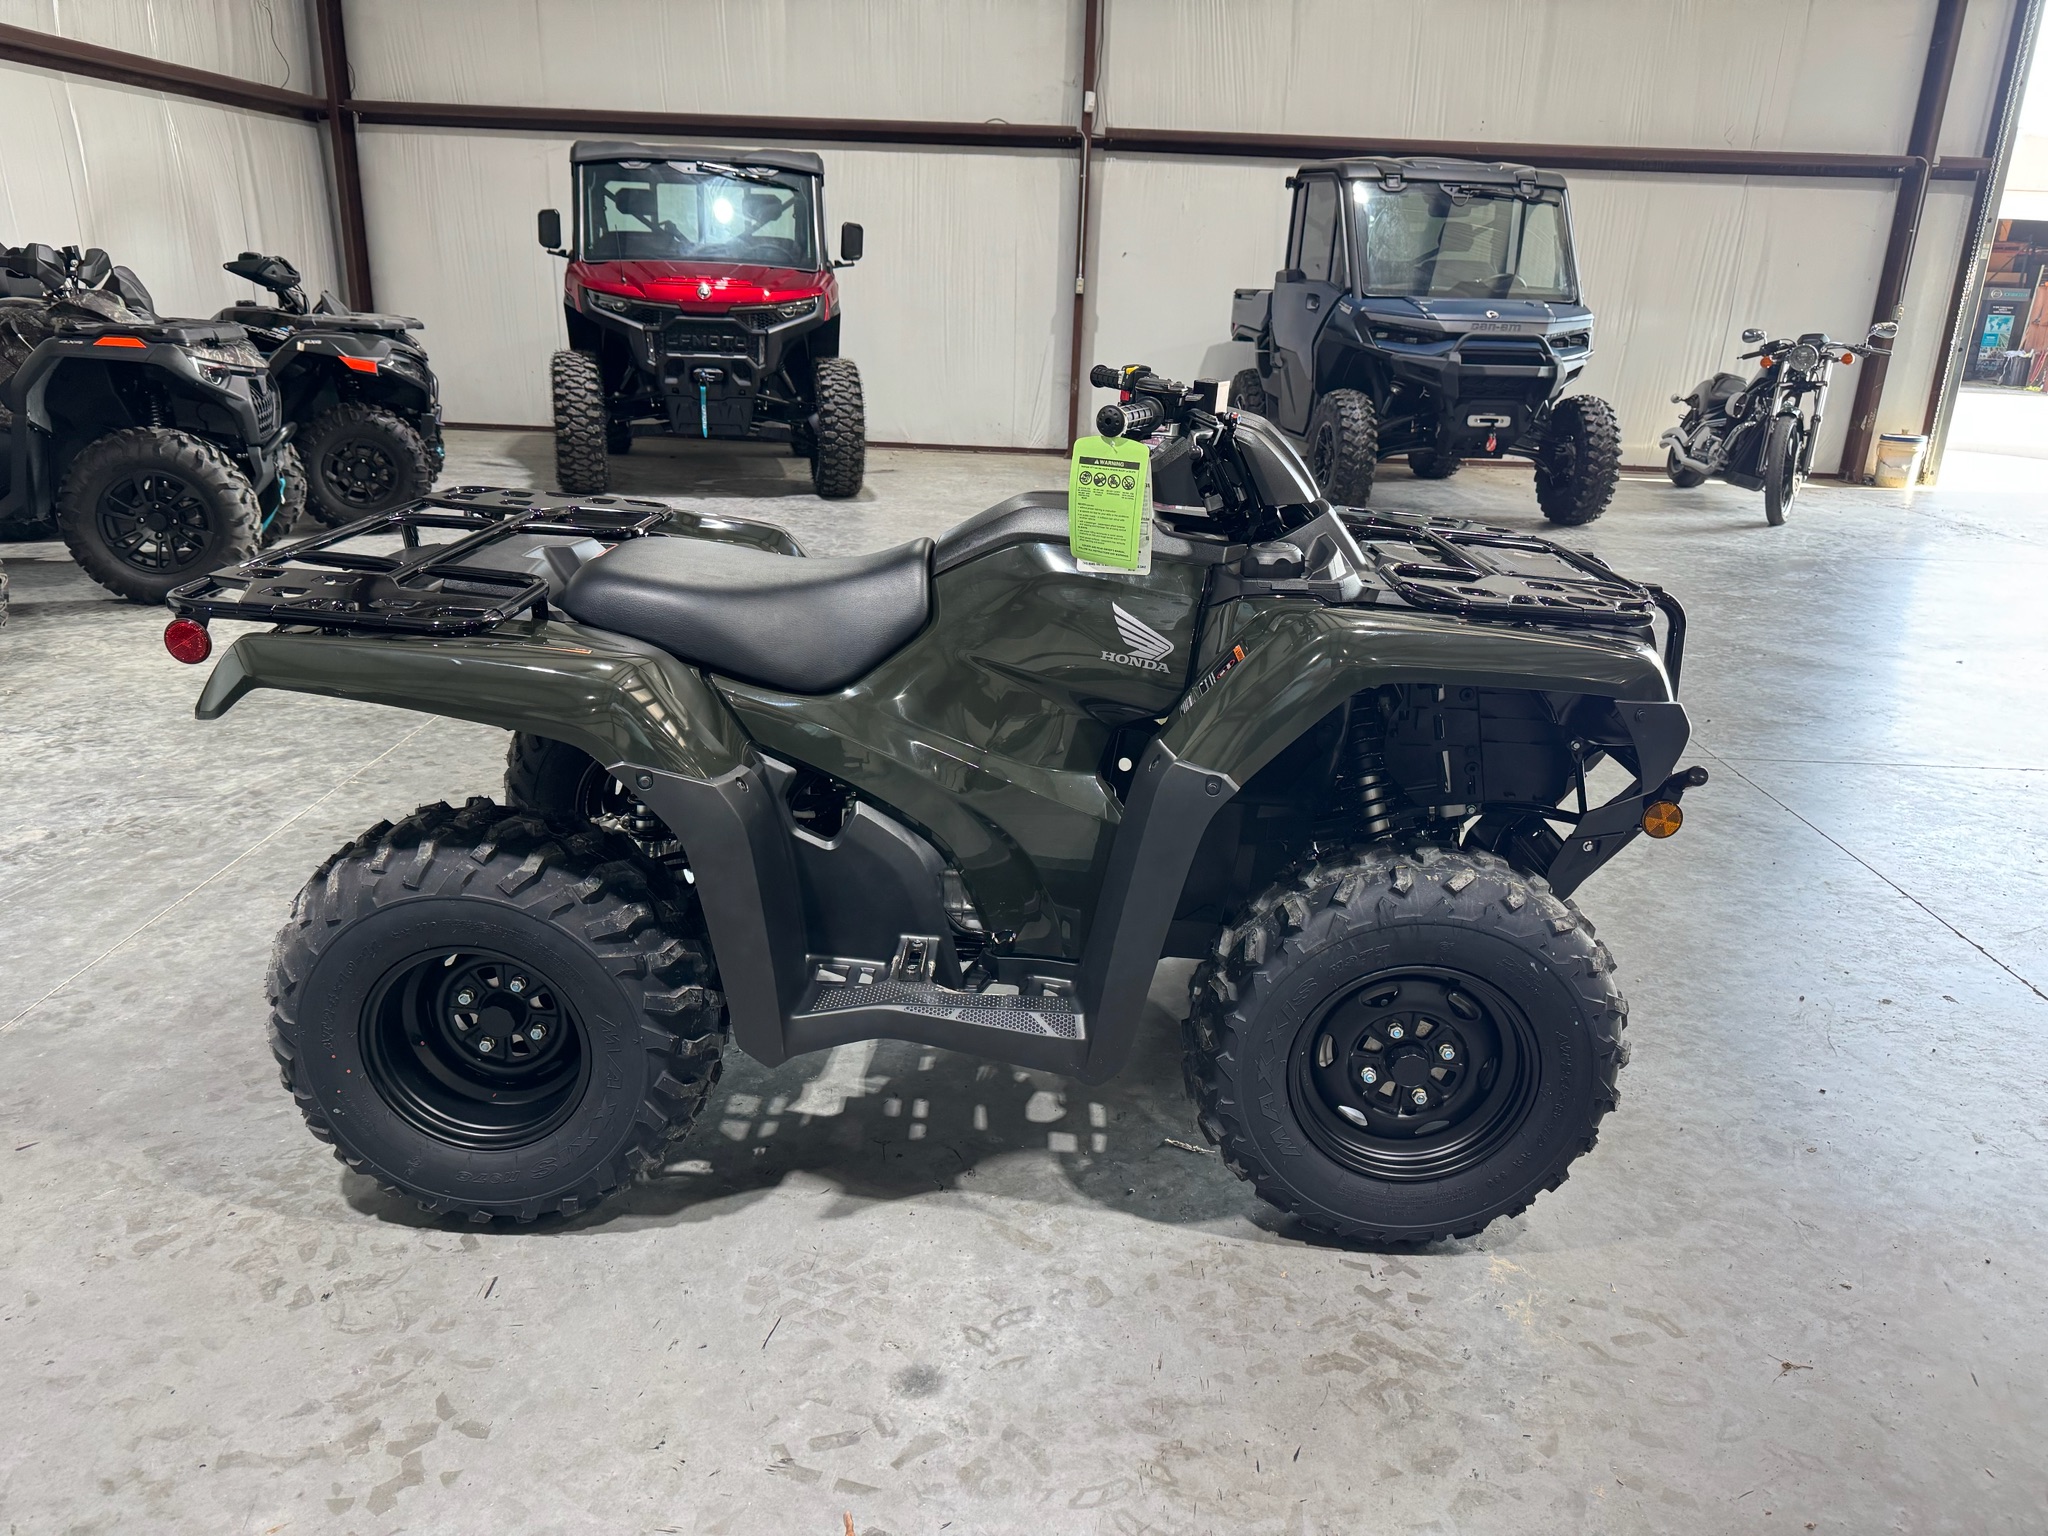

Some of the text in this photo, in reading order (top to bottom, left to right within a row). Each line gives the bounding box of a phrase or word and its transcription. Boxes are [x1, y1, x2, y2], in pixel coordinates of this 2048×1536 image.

[1470, 322, 1522, 333] can-am
[665, 333, 748, 348] CFMOTO
[1099, 459, 1125, 468] WARNING
[1100, 650, 1171, 674] HONDA
[1254, 977, 1317, 1157] MAXXIS
[529, 1014, 623, 1180] MAXXIS
